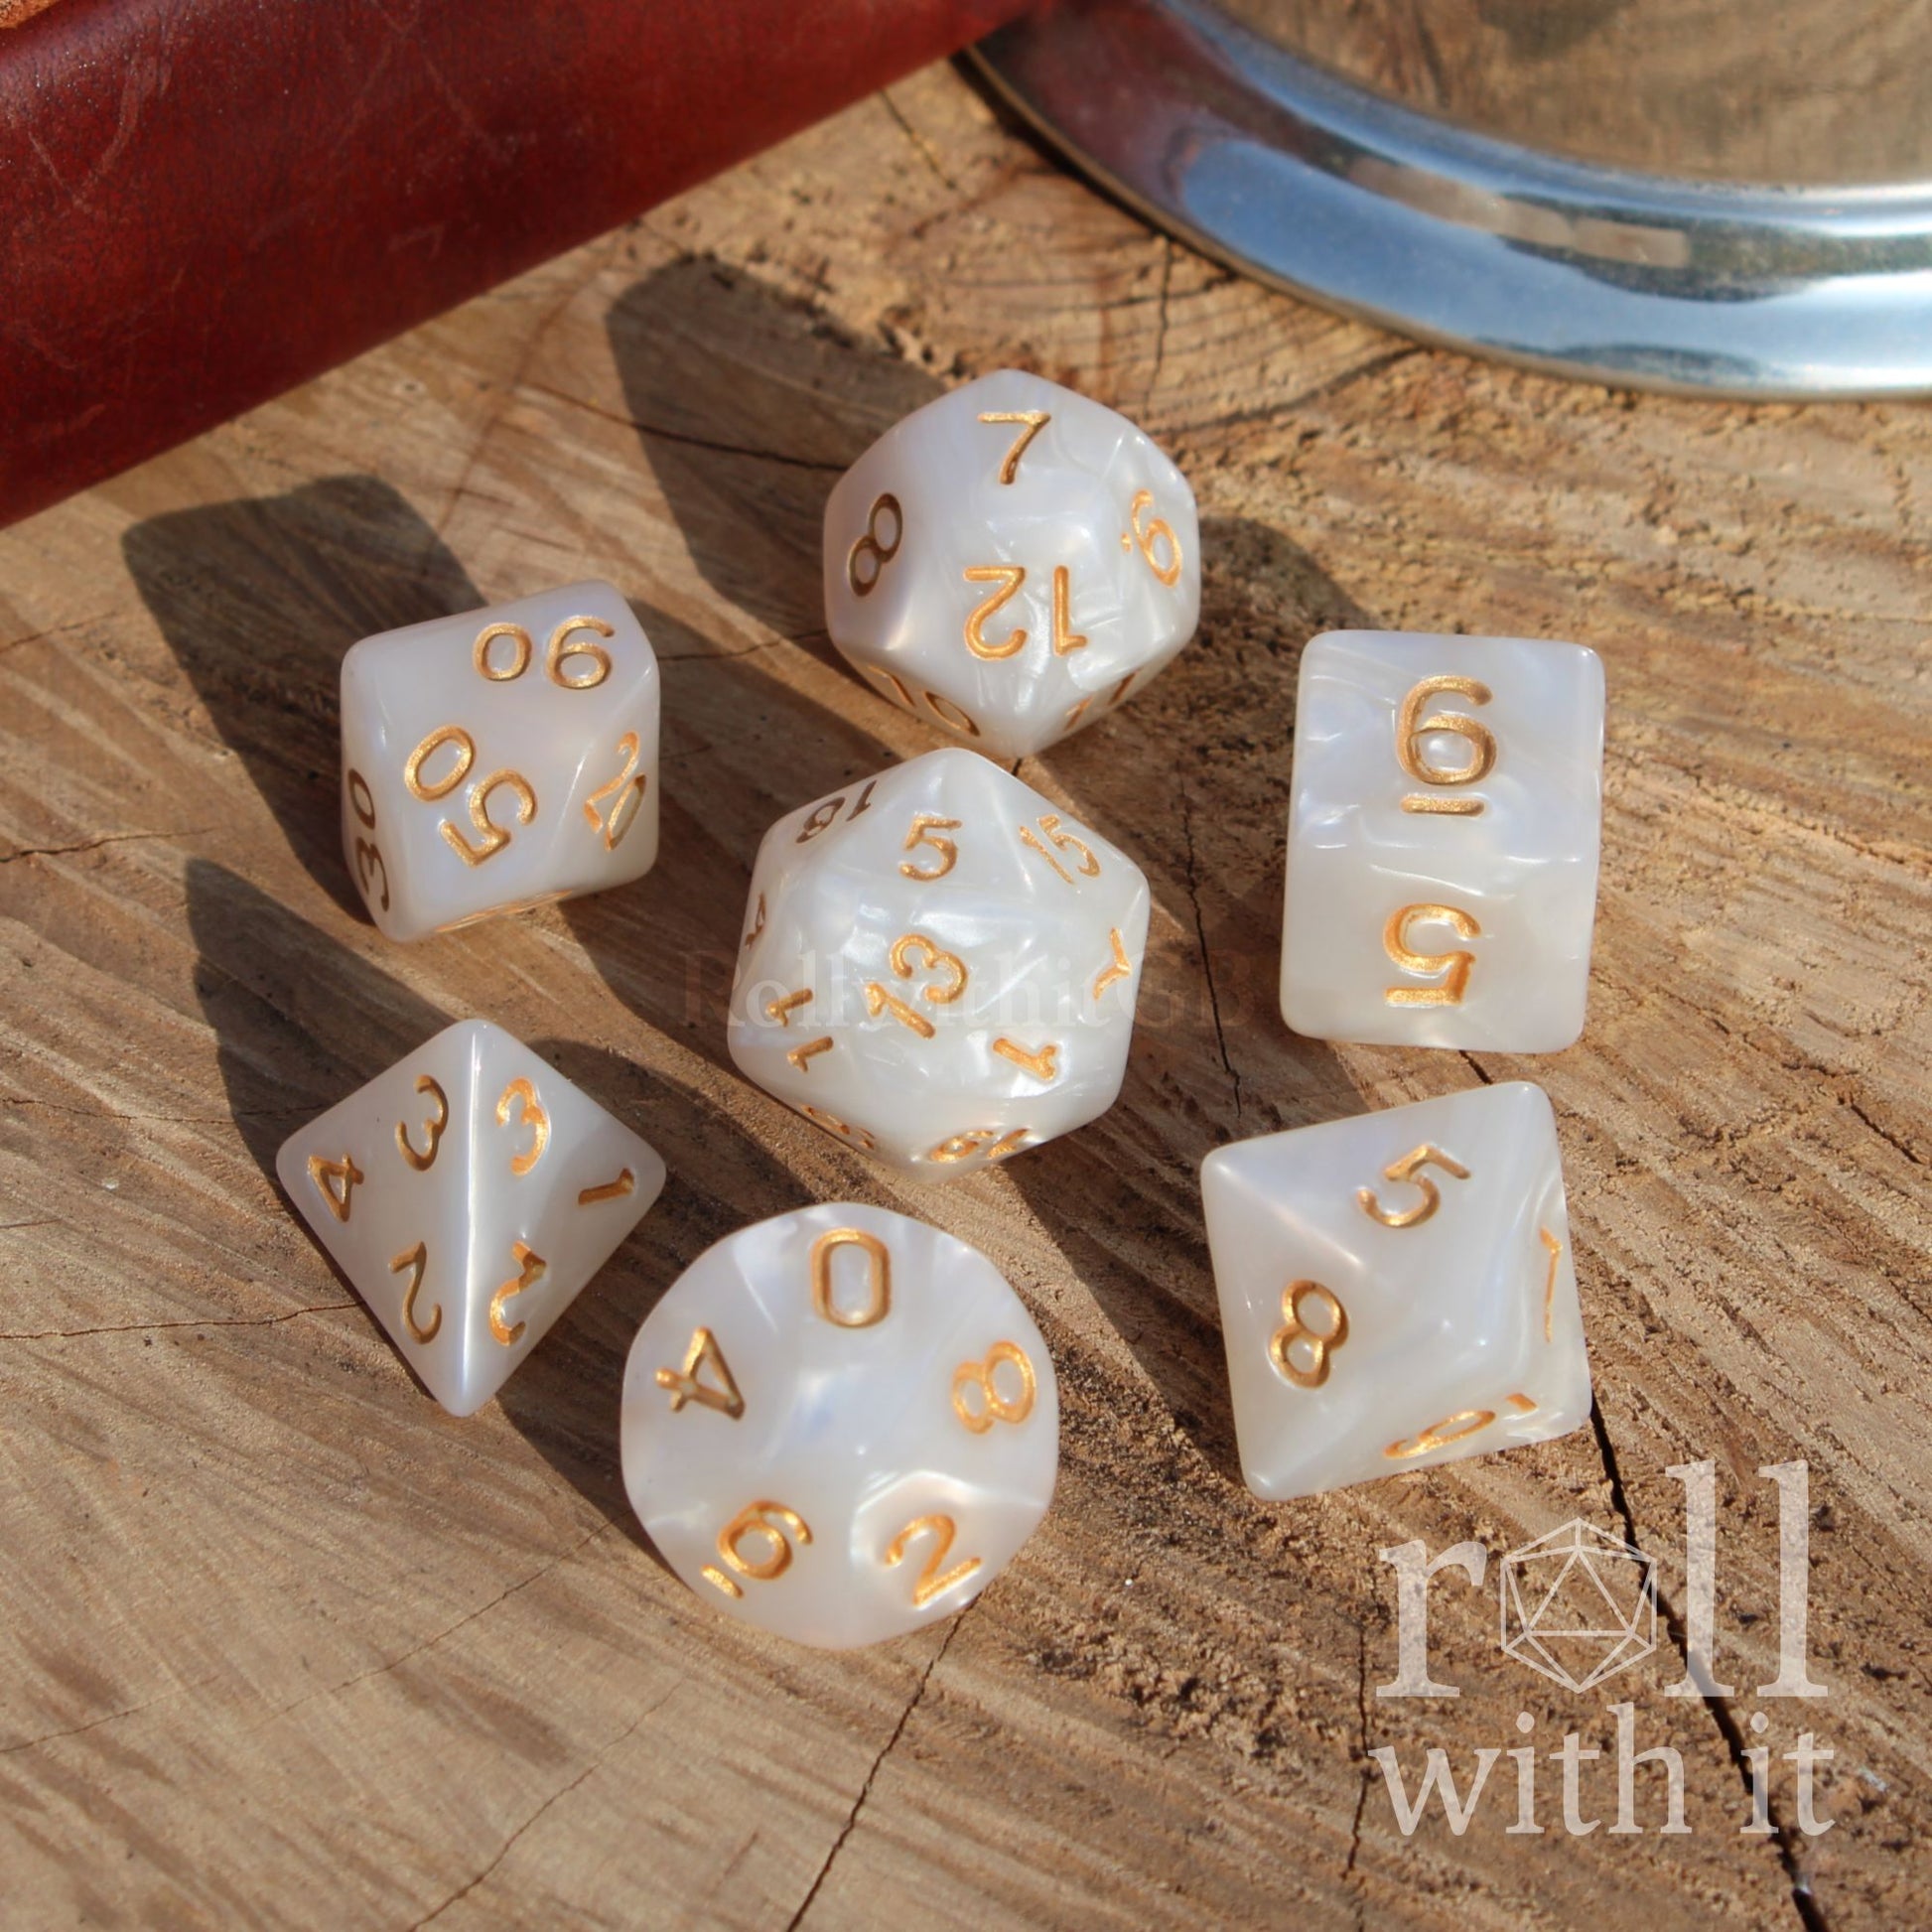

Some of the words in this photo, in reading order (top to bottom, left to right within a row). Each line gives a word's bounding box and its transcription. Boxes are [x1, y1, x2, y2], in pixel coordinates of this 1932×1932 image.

[977, 411, 1051, 485] 7
[847, 492, 903, 598] 8
[963, 565, 1088, 660] 12
[899, 812, 963, 883] 5
[1019, 813, 1102, 886] 15
[864, 933, 968, 1039] 13
[1382, 902, 1481, 1008] 5
[395, 1074, 449, 1172] 3
[496, 1075, 552, 1176] 3
[309, 1152, 364, 1223] 4
[578, 1168, 635, 1205] 1
[1356, 1143, 1471, 1230] 5
[389, 1240, 442, 1344] 2
[489, 1240, 548, 1346] 2
[810, 1227, 892, 1329] 0
[654, 1325, 746, 1422] 4
[1268, 1278, 1350, 1390] 8
[951, 1339, 1037, 1435] 8
[885, 1514, 982, 1611] 2
